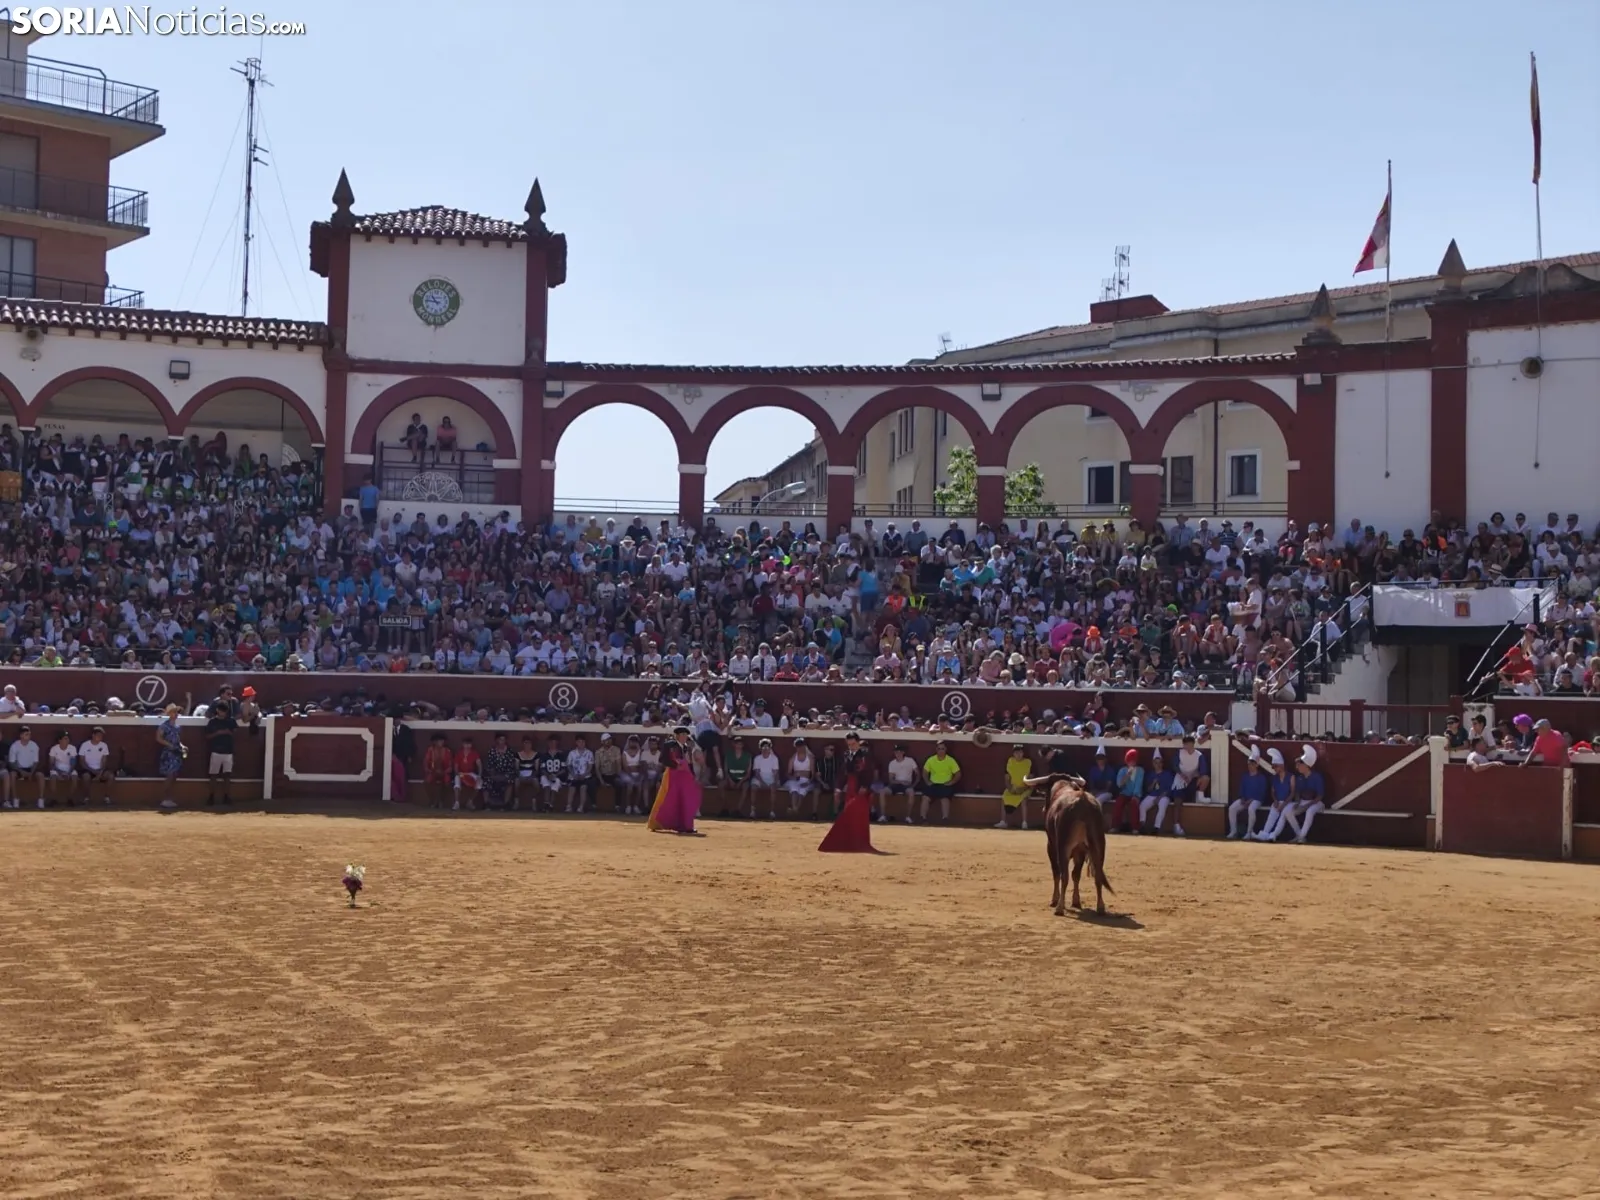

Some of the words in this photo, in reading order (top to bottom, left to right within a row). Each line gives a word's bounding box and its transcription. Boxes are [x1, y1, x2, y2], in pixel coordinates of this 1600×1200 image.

[416, 280, 457, 298] RELOJES
[416, 306, 457, 324] MONREAL
[145, 680, 159, 702] 7
[557, 686, 570, 708] 8
[950, 695, 963, 717] 8
[546, 759, 561, 773] 88
